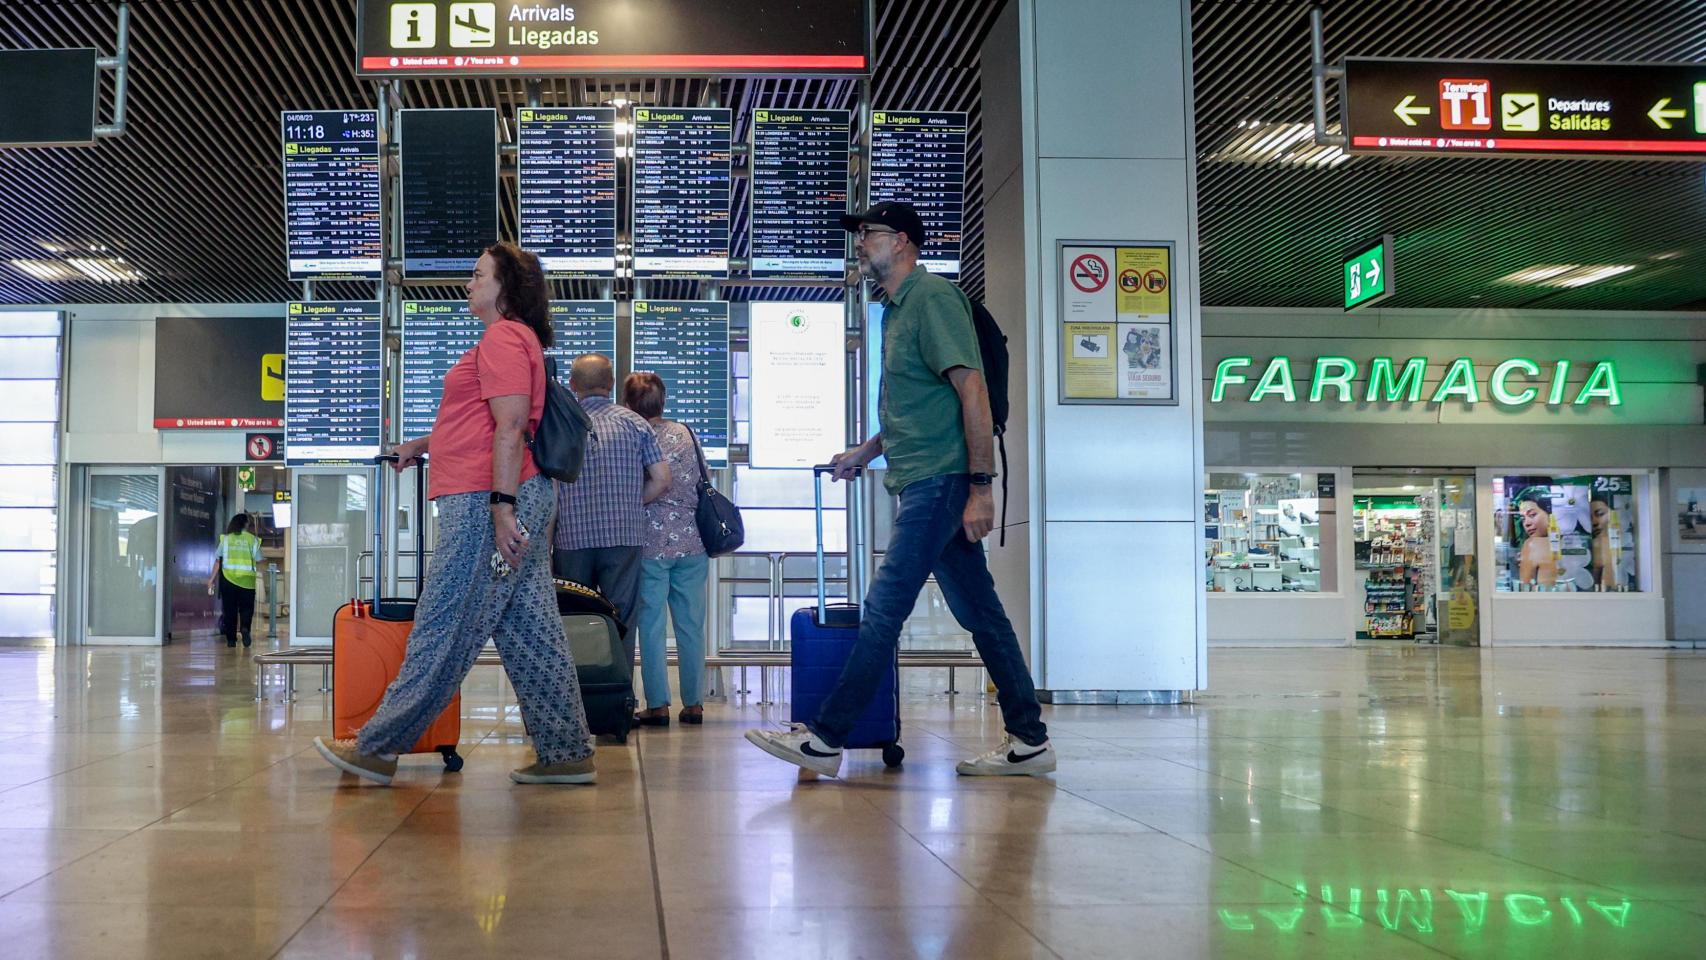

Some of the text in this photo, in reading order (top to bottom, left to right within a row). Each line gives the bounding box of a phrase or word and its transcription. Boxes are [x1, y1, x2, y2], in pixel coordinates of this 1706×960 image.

[509, 4, 574, 22] Arrivals
[509, 26, 599, 48] Llegadas
[1444, 82, 1487, 92] Terminal
[1443, 92, 1490, 124] T1
[1548, 98, 1610, 112] Departures
[651, 113, 684, 121] Llegadas
[1550, 114, 1610, 131] Salidas
[287, 126, 324, 138] 11:18
[1211, 356, 1622, 406] FARMACIA
